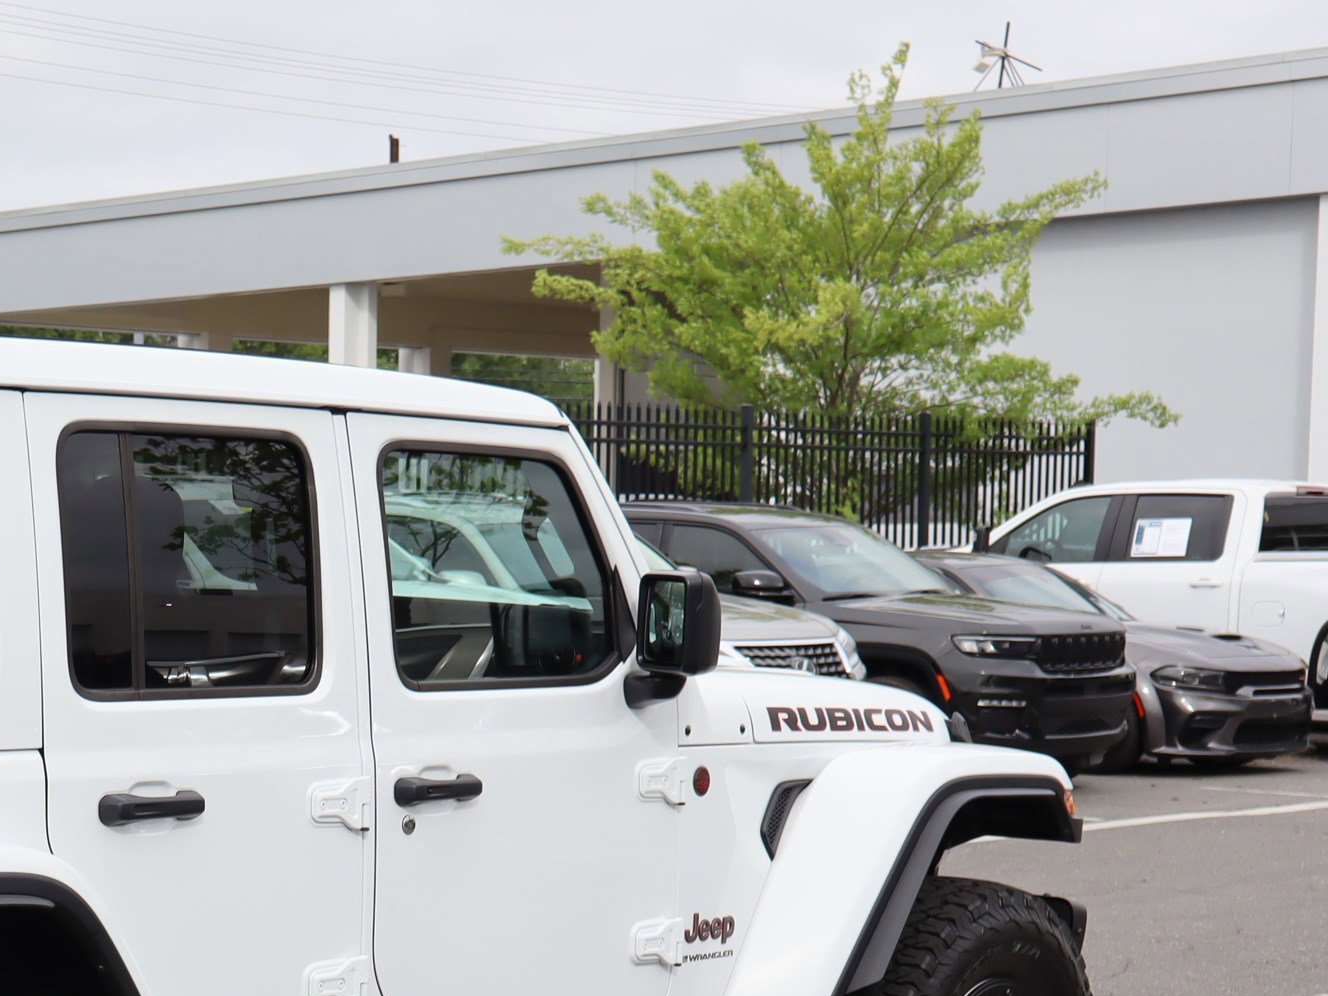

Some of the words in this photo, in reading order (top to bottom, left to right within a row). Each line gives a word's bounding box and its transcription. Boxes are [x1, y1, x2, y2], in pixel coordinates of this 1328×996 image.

[766, 707, 934, 732] RUBICON
[684, 912, 735, 945] Jeep
[688, 949, 734, 962] WRANGLER
